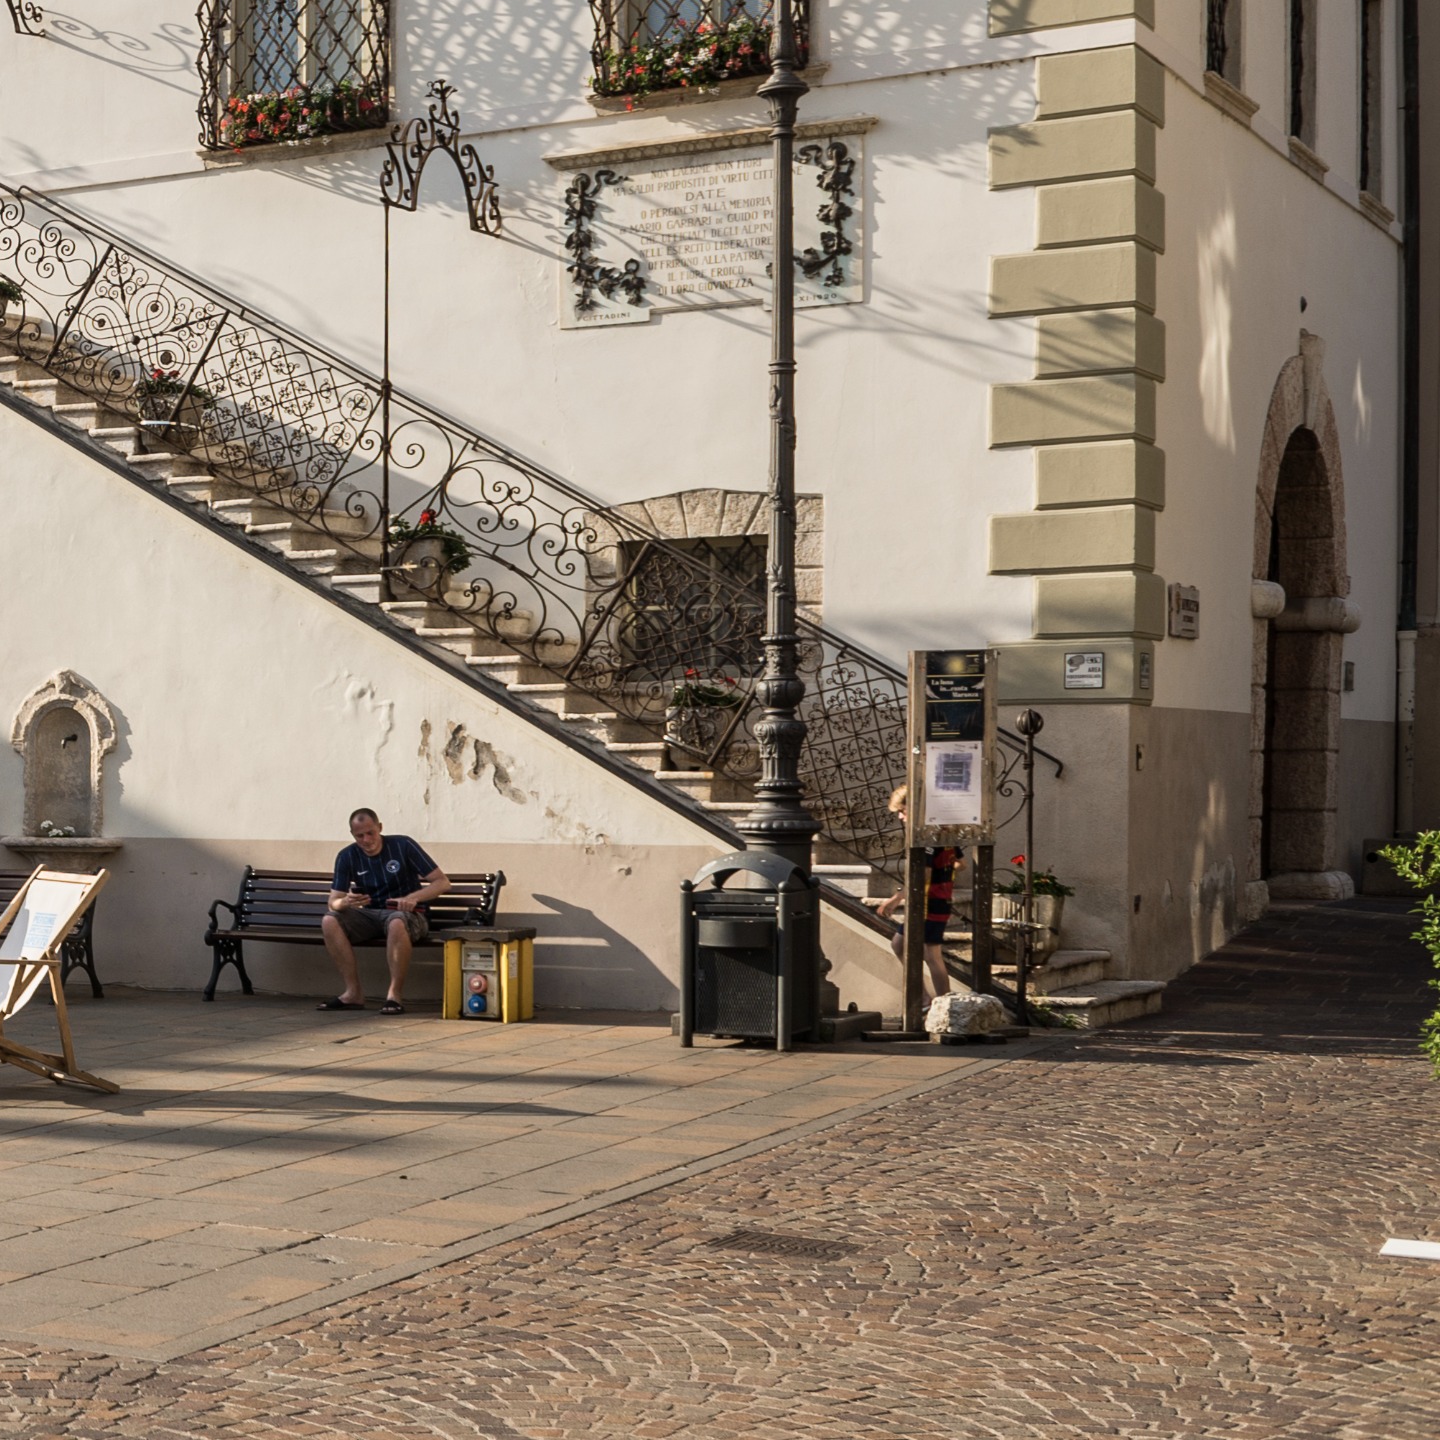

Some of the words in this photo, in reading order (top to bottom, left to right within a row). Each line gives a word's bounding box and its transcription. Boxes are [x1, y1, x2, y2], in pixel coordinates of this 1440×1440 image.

[651, 168, 671, 180] NON
[715, 161, 734, 173] NON
[736, 157, 763, 169] FIORI
[628, 183, 654, 197] SALDI
[657, 178, 706, 193] PROPOSITI
[708, 176, 719, 187] DI
[685, 188, 727, 202] DATE
[641, 210, 647, 220] O
[650, 204, 698, 219] PERGINESI
[701, 200, 726, 213] ALLA
[729, 196, 772, 211] MEMORIA
[630, 222, 662, 235] MARIO
[727, 211, 758, 224] GUIDO
[711, 226, 738, 239] DEGLI
[741, 222, 773, 235] ALPINI
[714, 236, 774, 252] LIBERATORE
[648, 257, 699, 271] OFFRIRONO
[702, 253, 727, 266] ALLA
[730, 250, 765, 263] PATRIA
[668, 272, 678, 282] IL
[681, 268, 706, 281] FIORE
[711, 264, 744, 278] EROICO
[671, 281, 695, 295] LORO
[698, 277, 755, 292] GIOVINEZZA
[582, 312, 631, 322] CITTADINI
